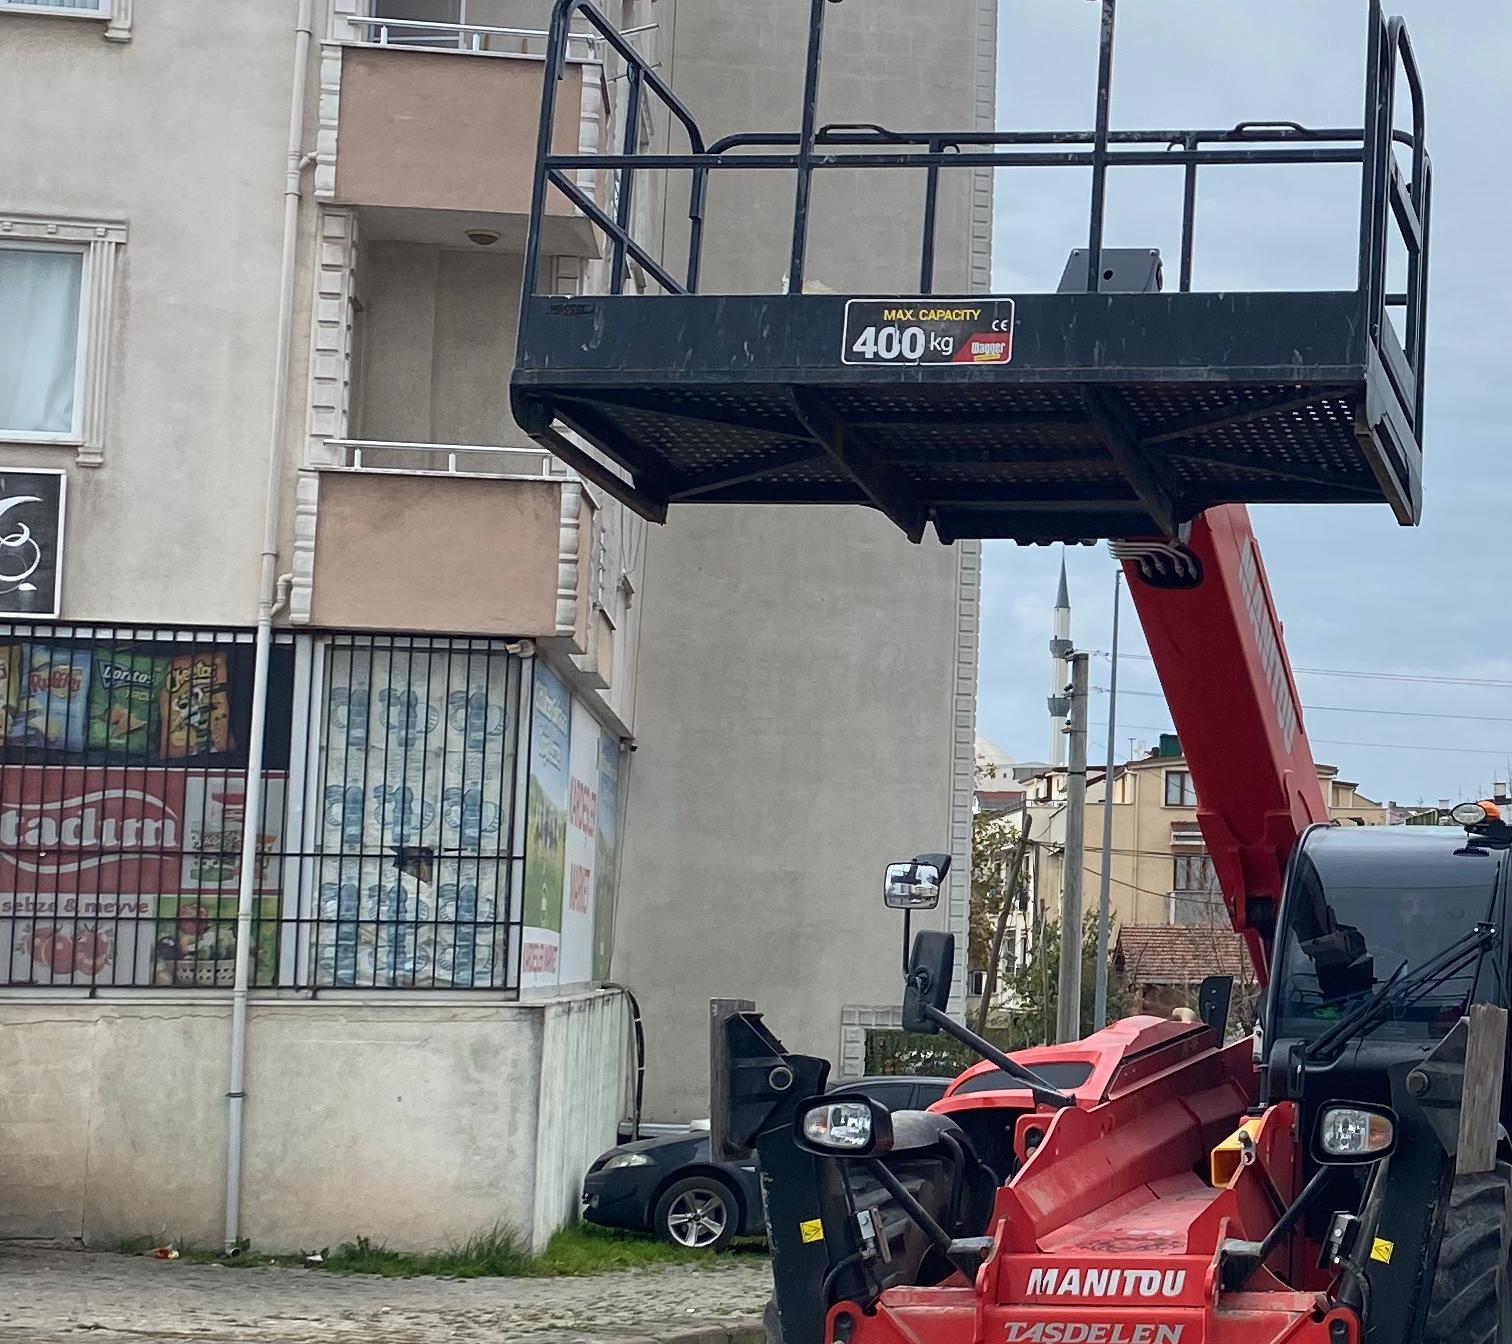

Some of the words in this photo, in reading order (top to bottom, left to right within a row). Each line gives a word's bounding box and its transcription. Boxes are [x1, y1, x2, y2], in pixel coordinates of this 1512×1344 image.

[918, 309, 982, 322] CAPACITY
[852, 326, 926, 360] 400
[929, 331, 954, 356] kg
[1025, 1268, 1187, 1297] MANITOU
